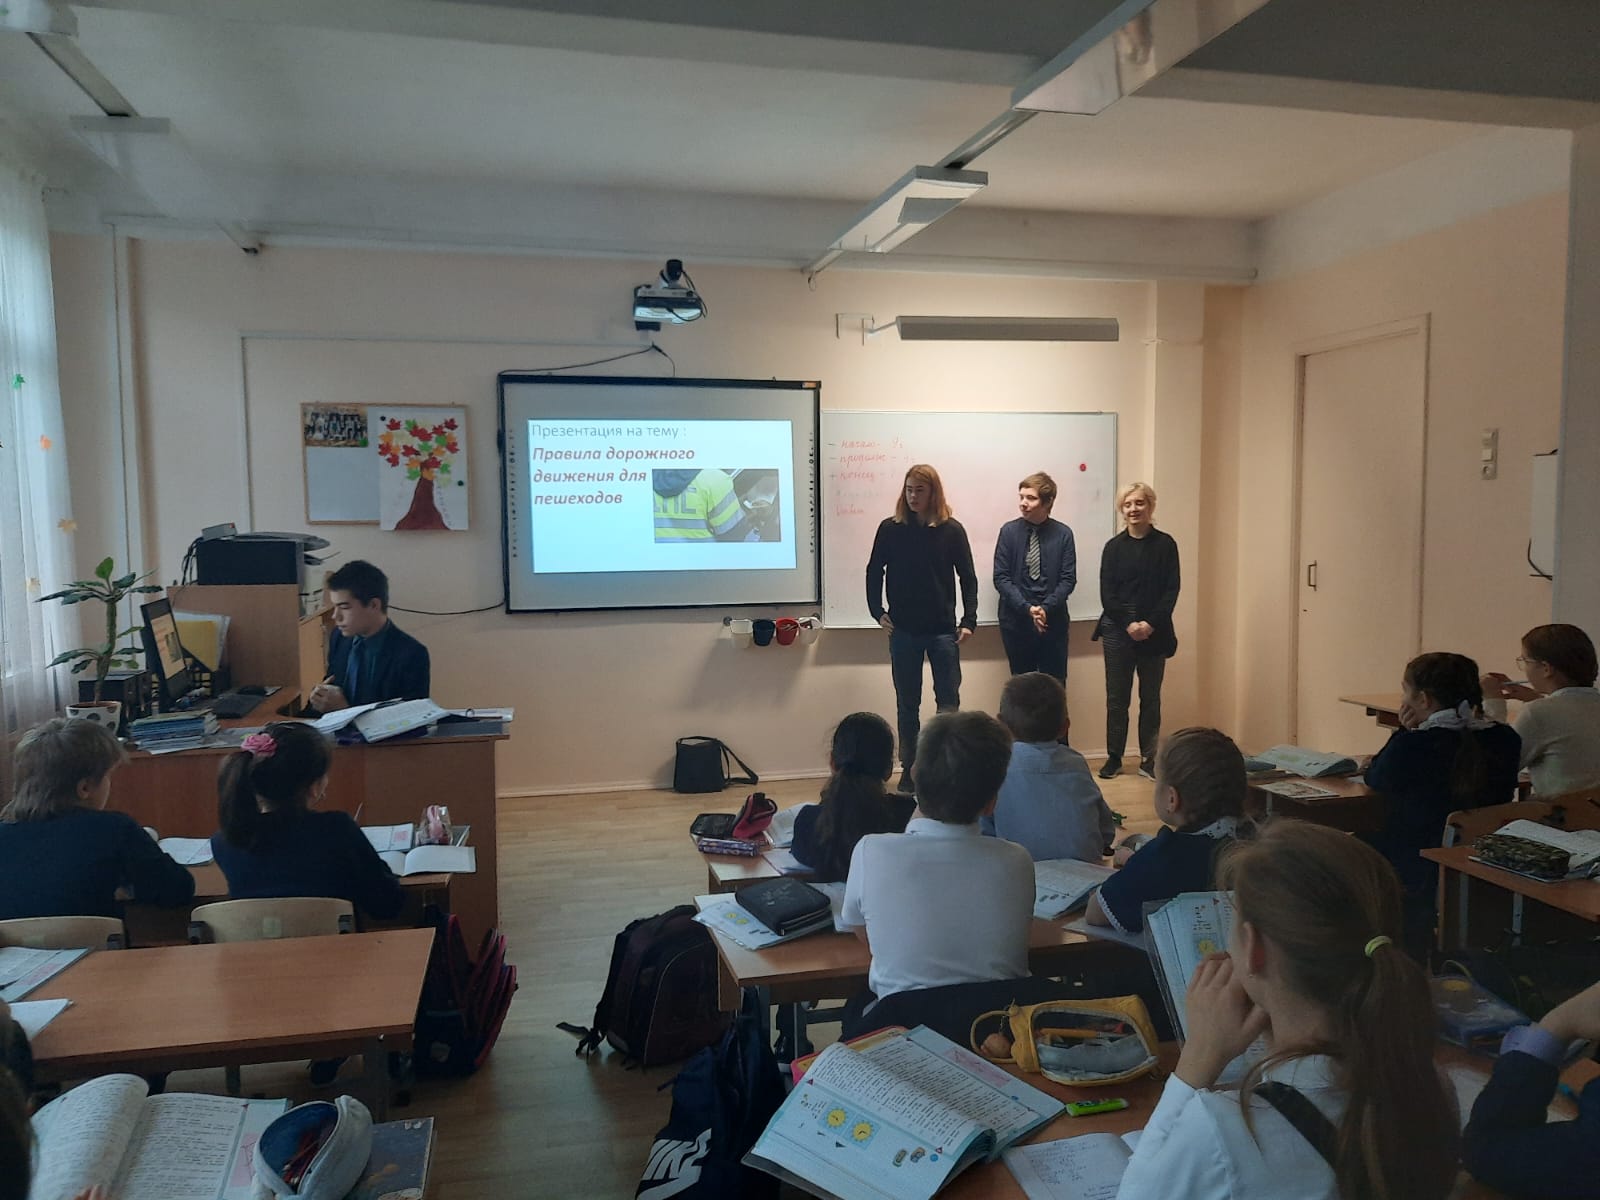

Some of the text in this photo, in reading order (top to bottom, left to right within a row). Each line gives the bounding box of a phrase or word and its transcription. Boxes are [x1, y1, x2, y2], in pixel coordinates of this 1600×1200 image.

[531, 424, 622, 439] Презентация
[627, 427, 642, 437] на
[648, 426, 679, 439] тему
[532, 446, 695, 463] Правила дорожного
[533, 468, 647, 483] движения для
[534, 490, 623, 505] пешеходов
